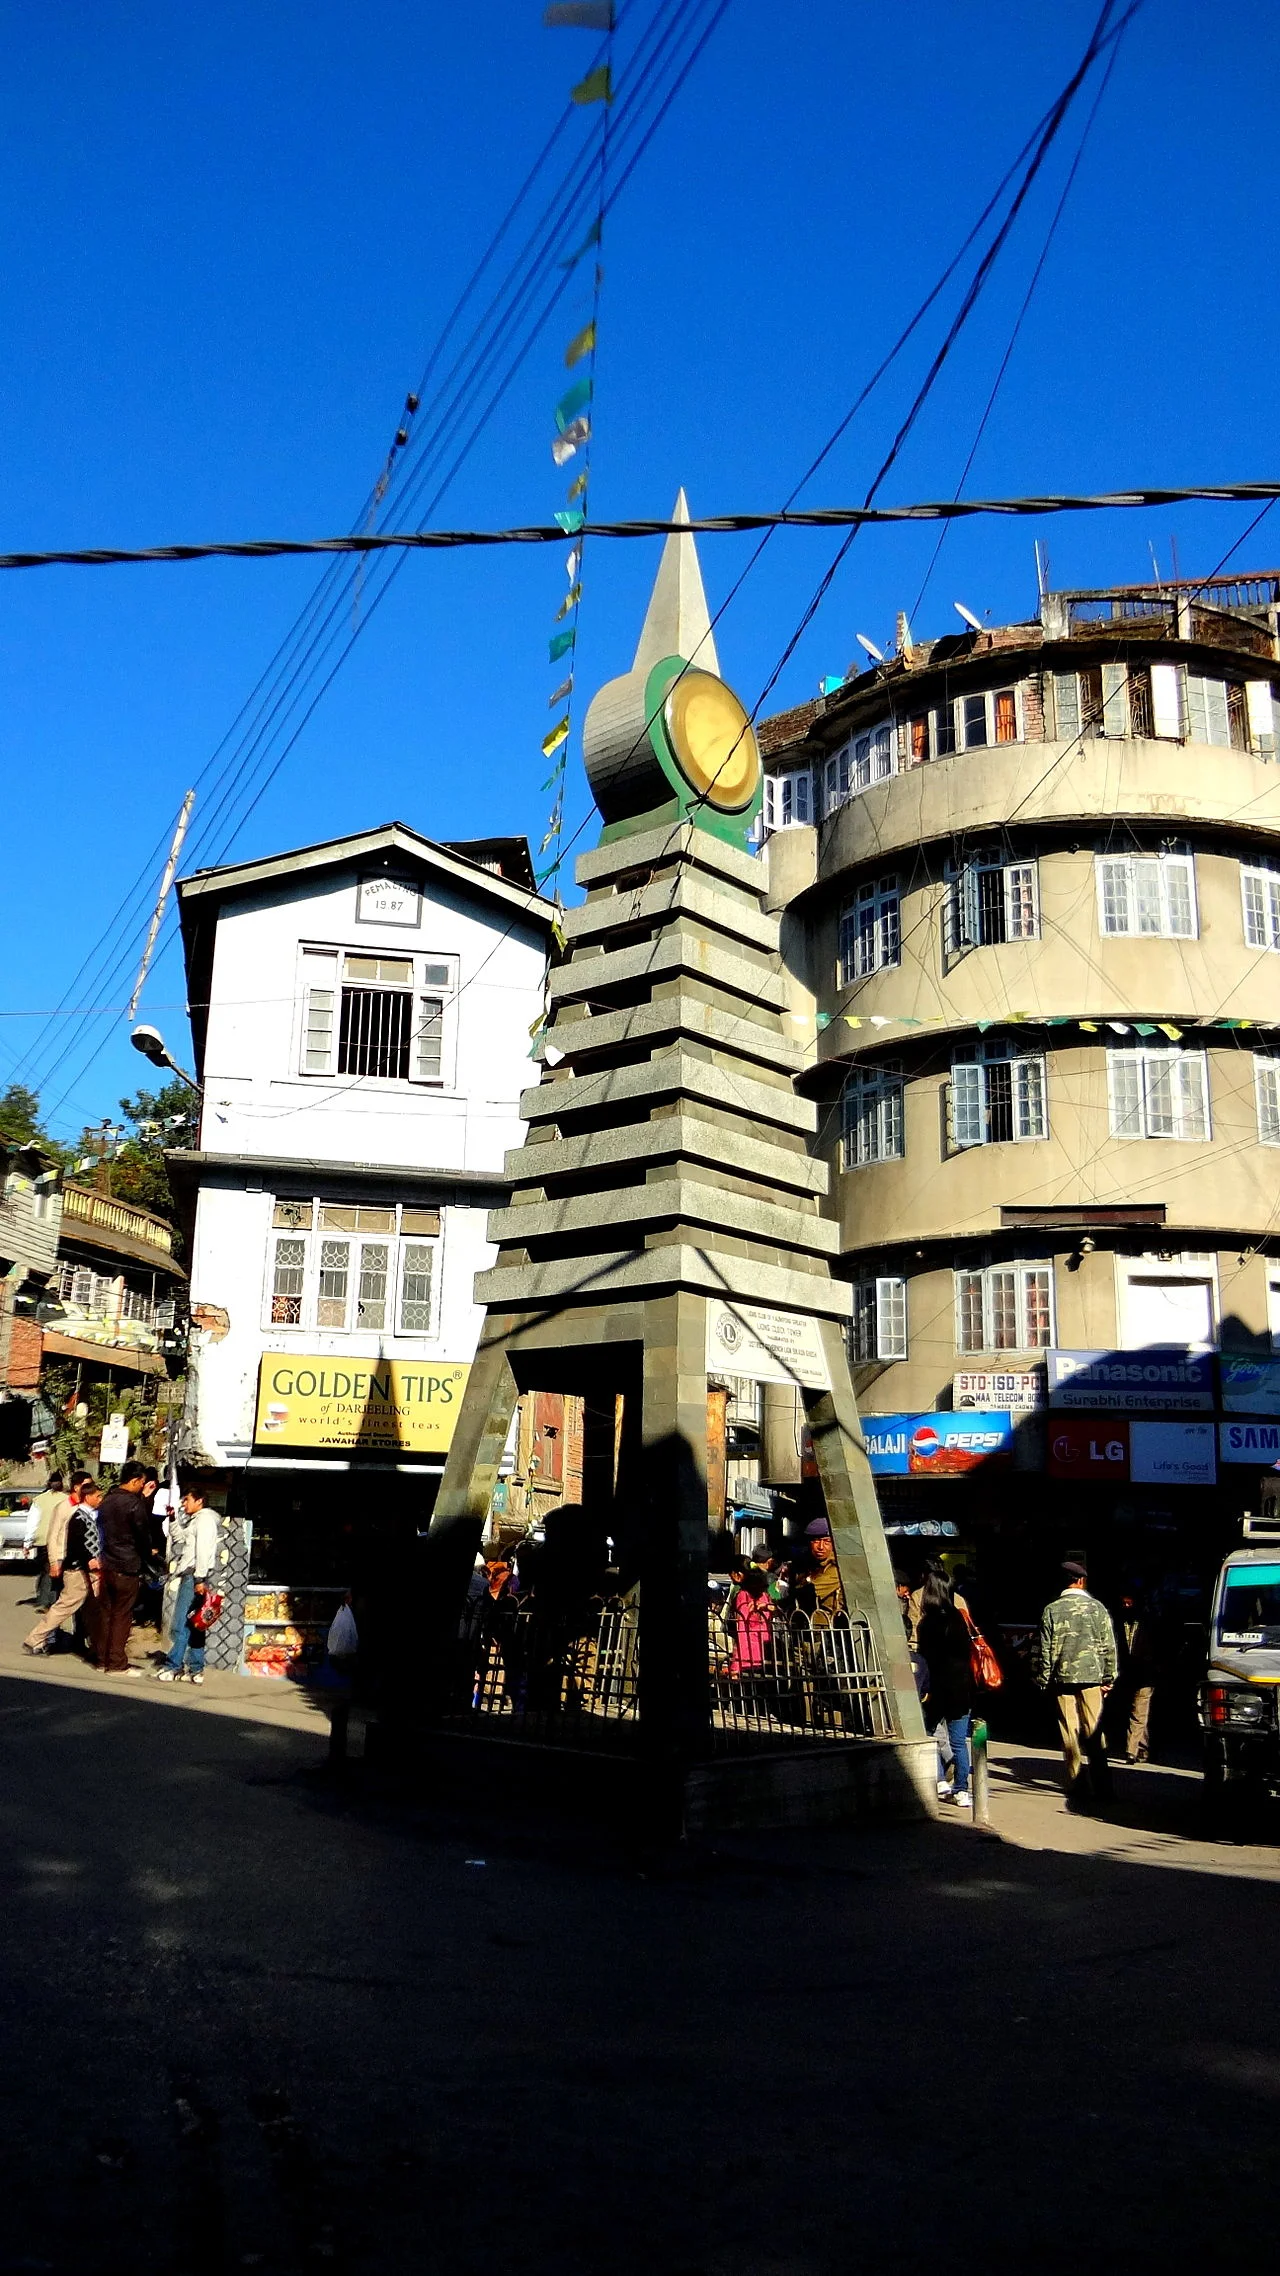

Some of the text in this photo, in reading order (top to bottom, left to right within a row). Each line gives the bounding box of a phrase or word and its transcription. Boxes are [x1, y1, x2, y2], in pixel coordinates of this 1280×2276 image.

[1055, 1357, 1202, 1383] Panasonic
[273, 1369, 391, 1401] GOLDEN
[994, 1393, 1024, 1402] TELECOM
[1063, 1393, 1201, 1410] Surabhi Enterprise
[320, 1403, 411, 1416] of DARJEELING
[298, 1415, 440, 1430] world's finest teas
[318, 1436, 411, 1447] JAWAHAR STORES
[944, 1431, 1004, 1449] PEPSI
[1089, 1440, 1124, 1461] LG
[1182, 1461, 1209, 1471] Good
